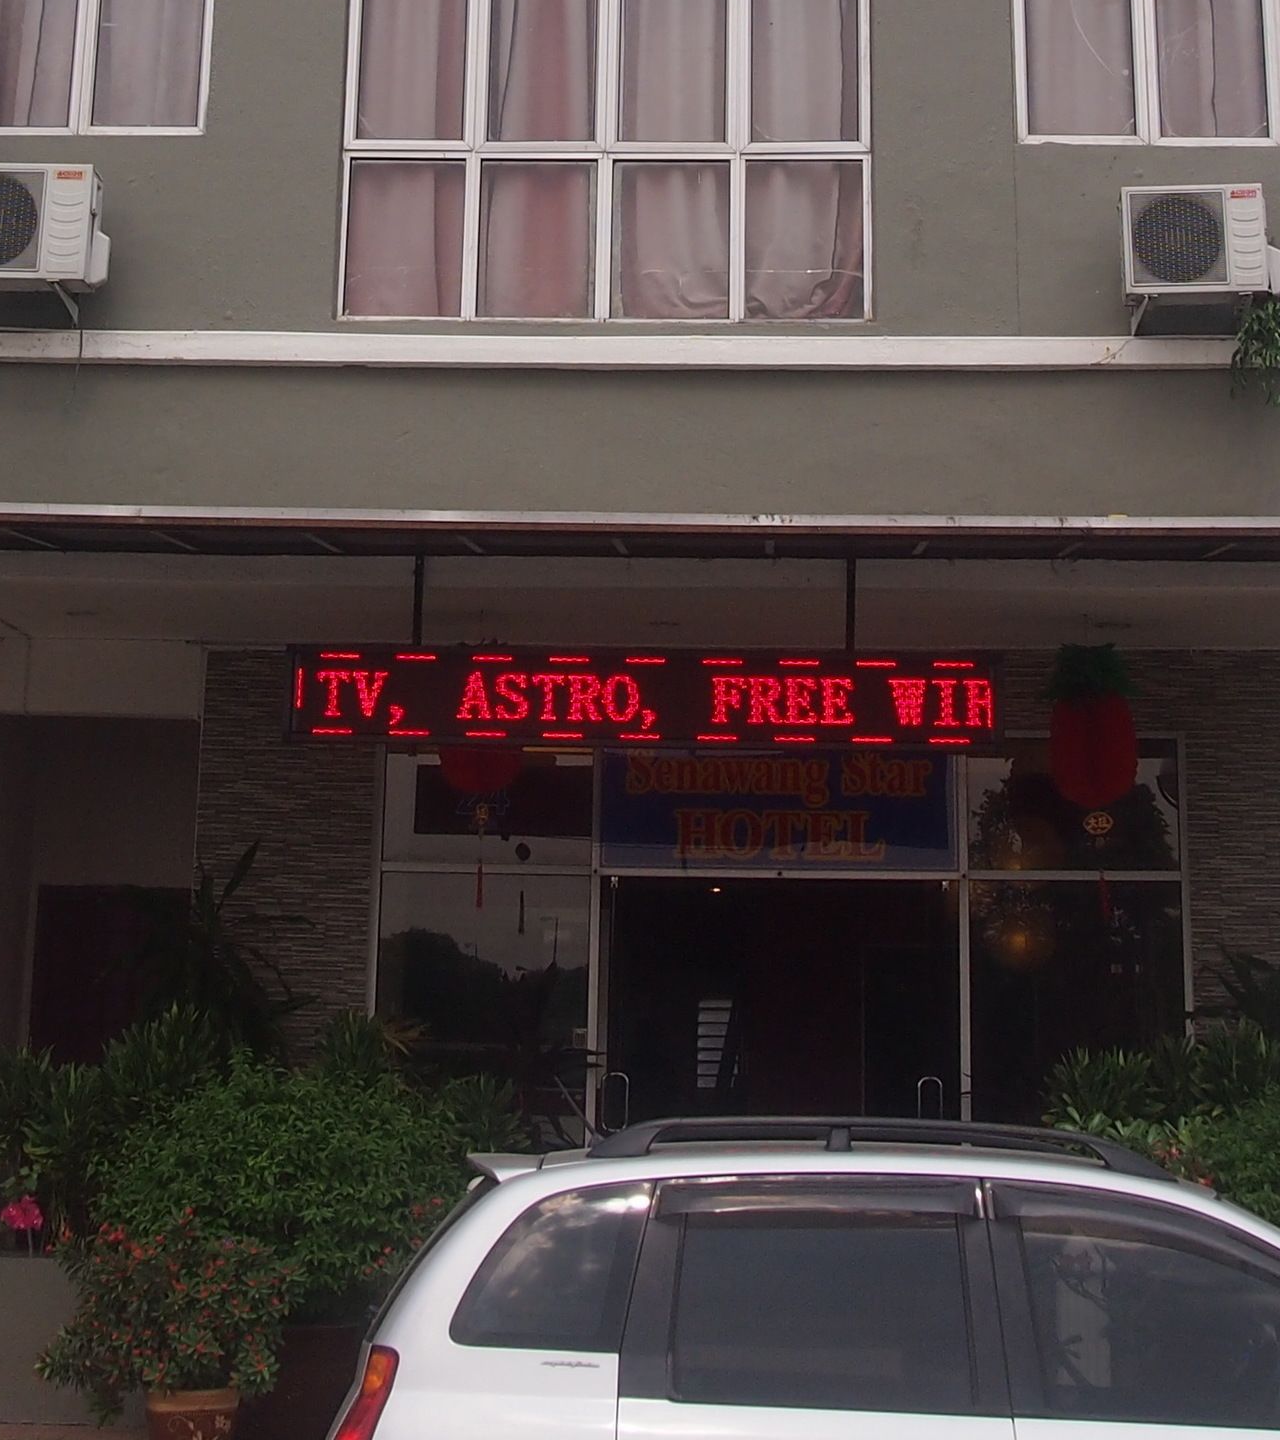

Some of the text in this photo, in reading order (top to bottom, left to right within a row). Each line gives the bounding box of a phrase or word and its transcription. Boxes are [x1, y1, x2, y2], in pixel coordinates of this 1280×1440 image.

[317, 671, 405, 726] TV,
[457, 672, 658, 731] ASTRO,
[712, 677, 856, 727] FREE
[625, 748, 933, 808] Senawang Star
[673, 807, 887, 863] HOTEL
